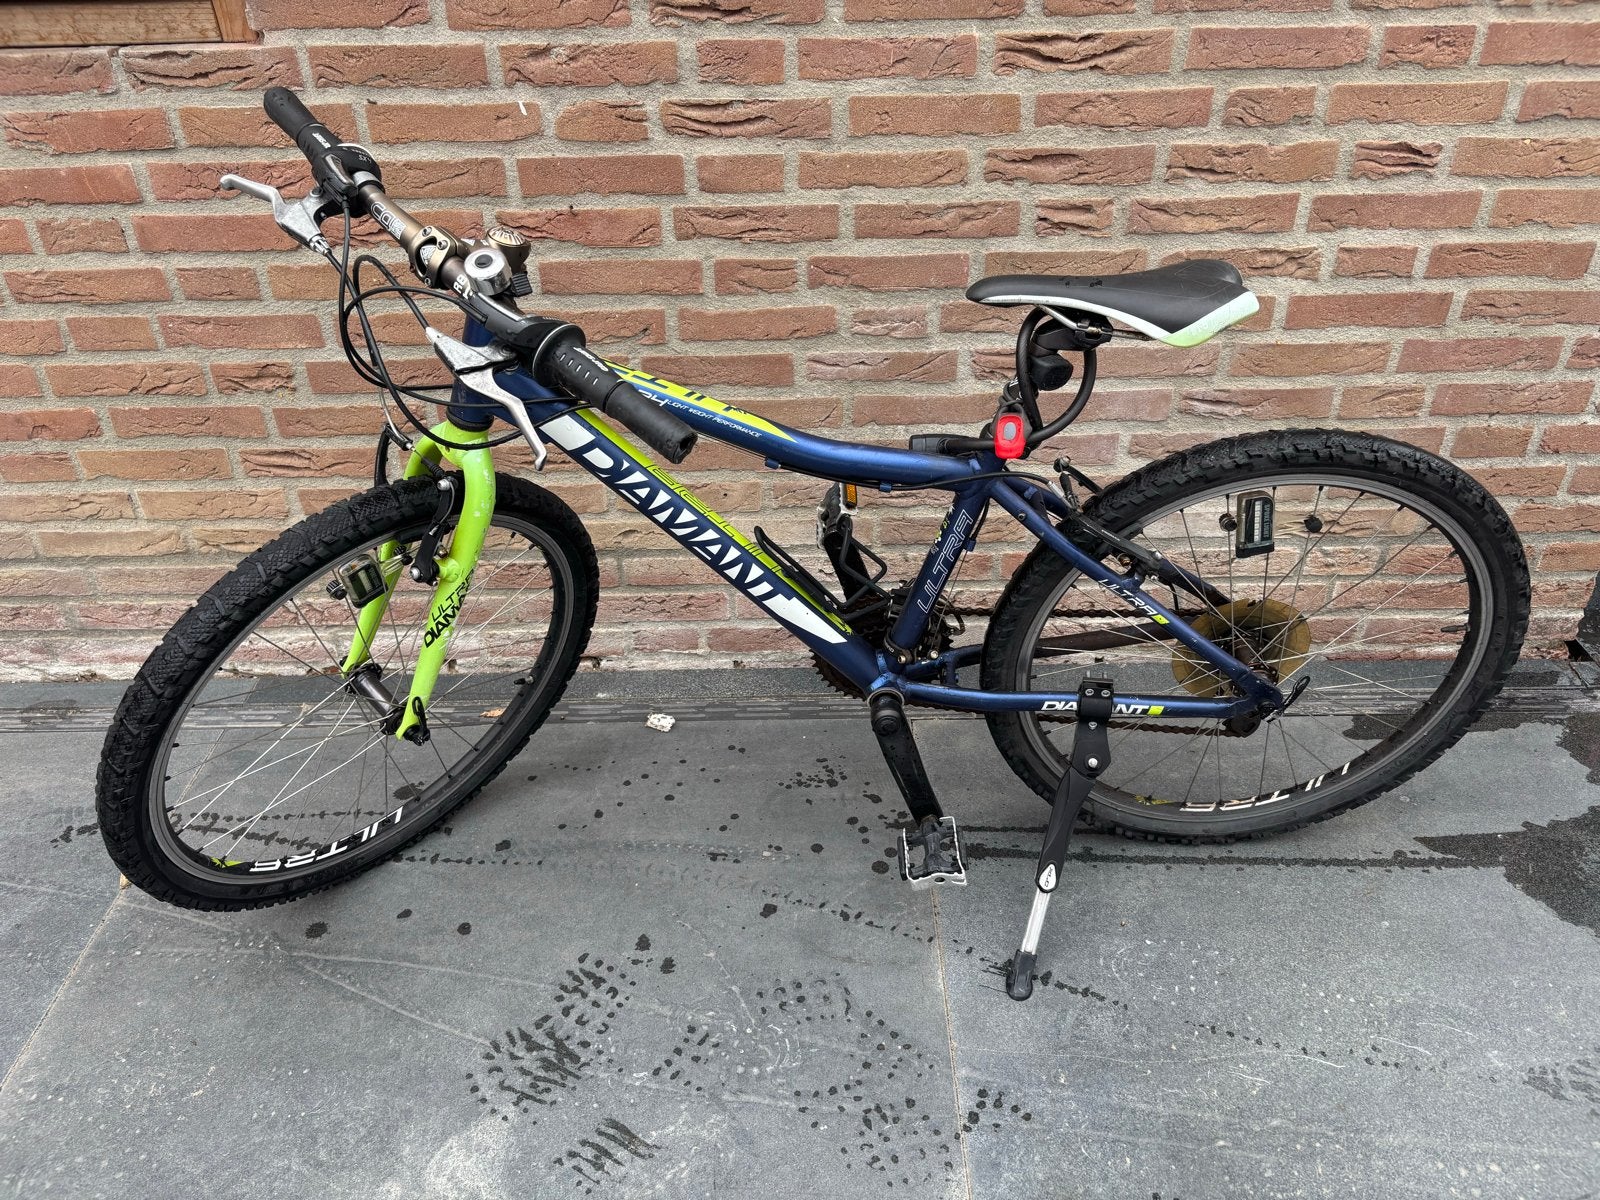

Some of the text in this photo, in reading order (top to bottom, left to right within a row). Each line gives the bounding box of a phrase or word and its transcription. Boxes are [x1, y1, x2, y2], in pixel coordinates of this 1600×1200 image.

[667, 400, 689, 410] LIGHT
[712, 416, 763, 438] PERFORMANCE
[572, 437, 796, 602] DIAMANT
[917, 509, 973, 614] ULTRA
[1098, 579, 1158, 615] ULTRA
